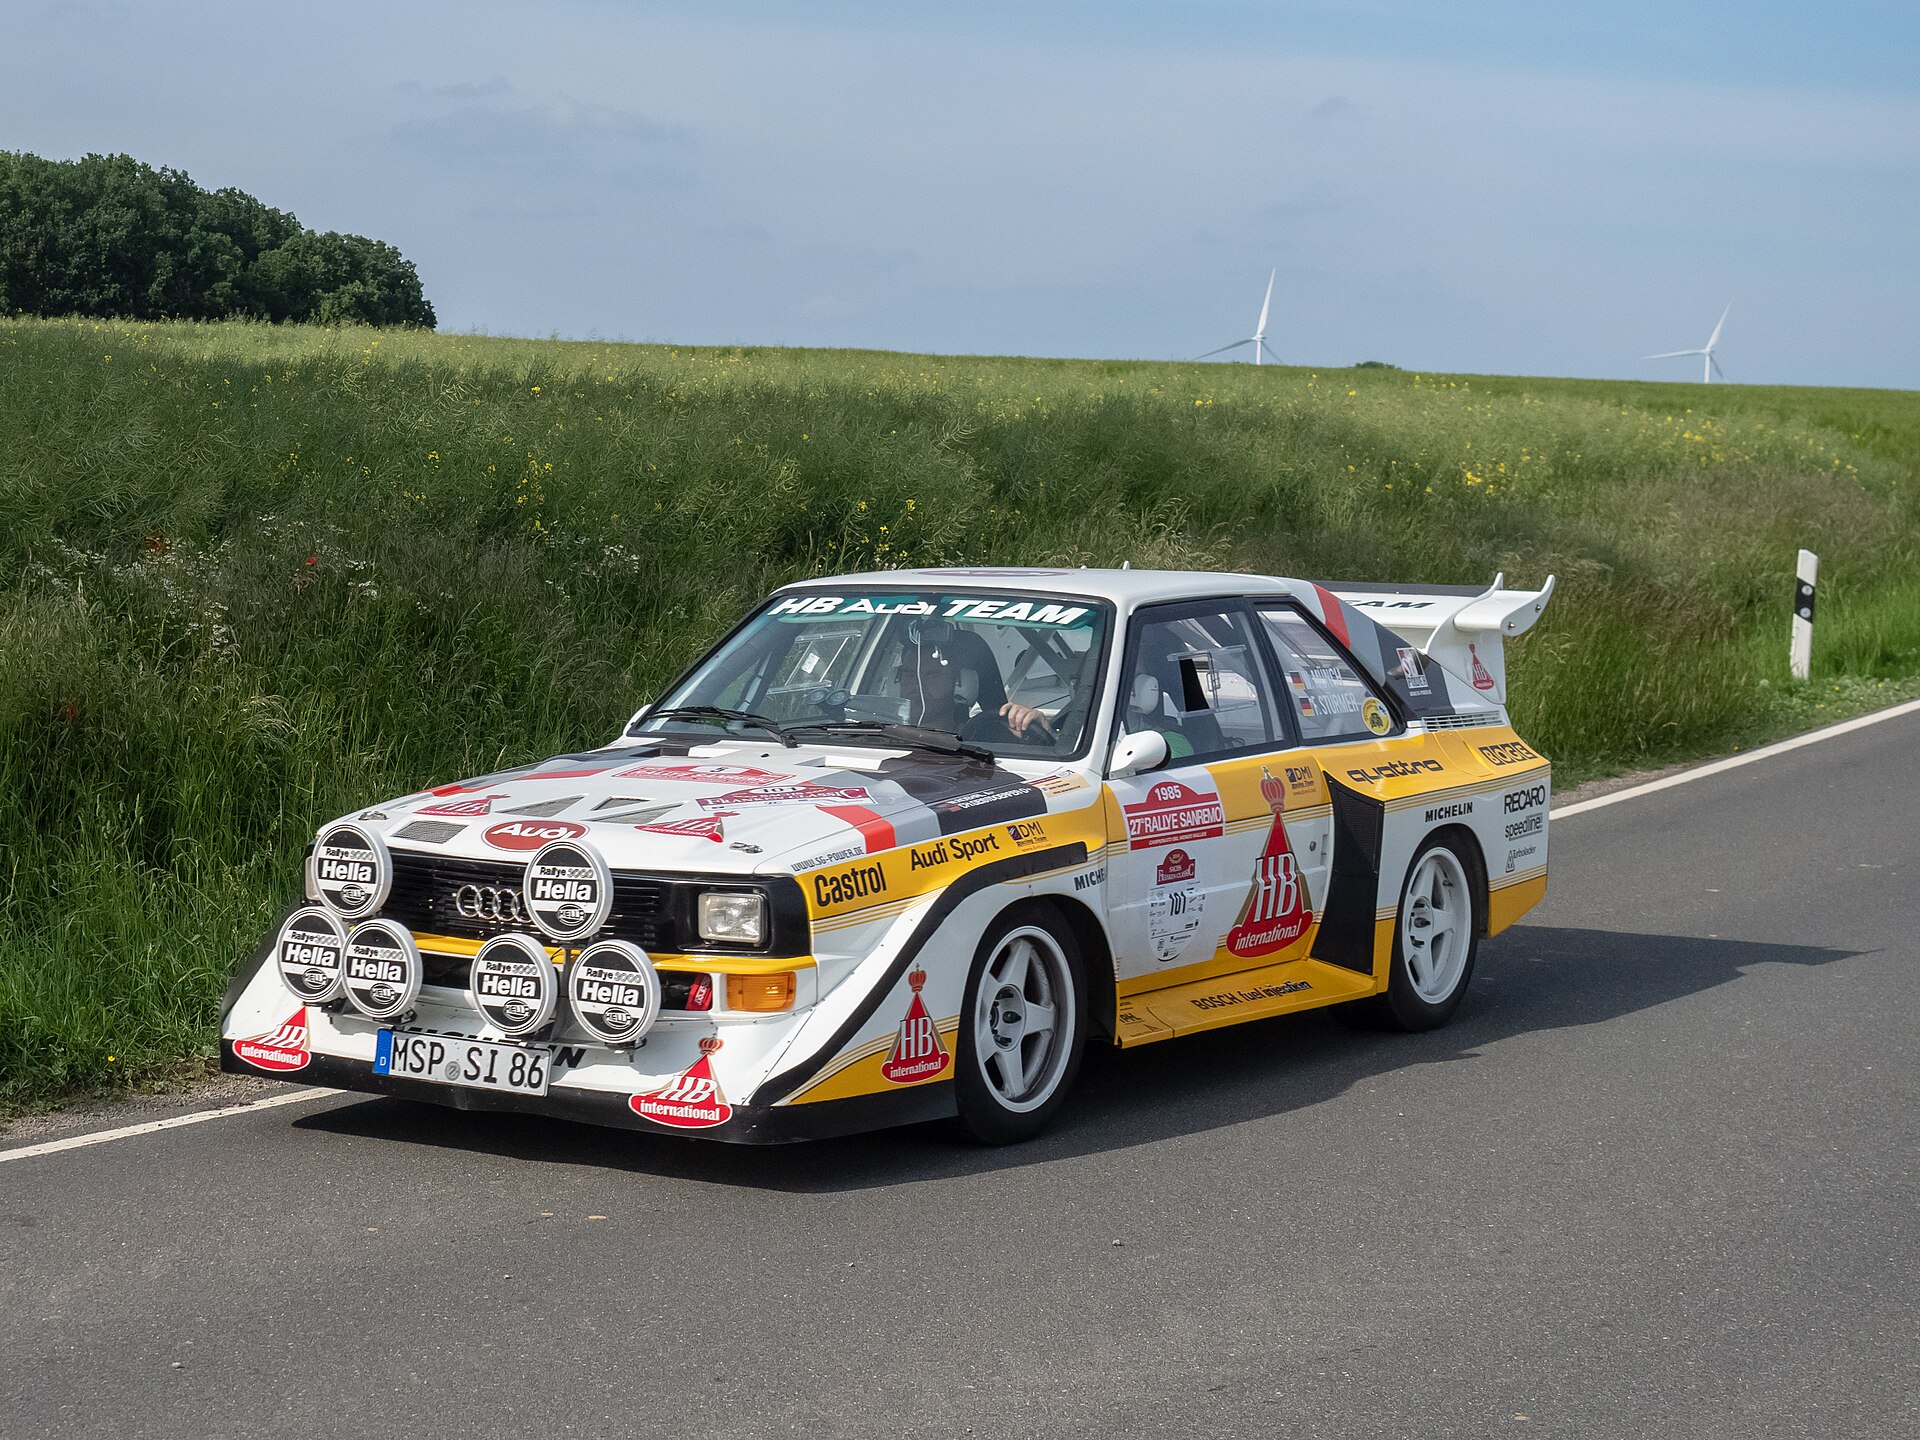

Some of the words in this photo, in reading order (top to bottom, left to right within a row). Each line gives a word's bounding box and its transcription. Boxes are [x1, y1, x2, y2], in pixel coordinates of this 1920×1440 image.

[767, 597, 845, 615] HB
[837, 598, 938, 616] Audi
[941, 599, 1090, 625] TEAM
[1478, 741, 1538, 766] BOGE
[1293, 766, 1313, 780] DMI
[1346, 759, 1444, 785] quattro
[1154, 785, 1182, 801] 1985
[1504, 785, 1546, 814] RECARO
[1144, 813, 1179, 834] RALLYE
[1179, 806, 1222, 828] SANREMO
[1424, 801, 1473, 823] MICHELIN
[495, 822, 578, 840] Audi
[663, 820, 721, 831] HB
[1018, 821, 1044, 837] DMI
[325, 847, 349, 859] Rallye
[910, 838, 949, 872] Audi
[952, 832, 1000, 862] Sport
[320, 859, 373, 882] Hella
[540, 866, 567, 877] Rallye
[567, 867, 595, 879] 3000
[535, 879, 592, 901] Hella
[813, 861, 888, 908] Castrol
[1253, 853, 1297, 923] HB
[1169, 891, 1187, 917] 101
[290, 931, 314, 943] Rallye
[1234, 917, 1303, 951] international
[284, 943, 336, 967] Hella
[354, 945, 379, 957] Rallye
[350, 957, 402, 980] Hella
[485, 961, 512, 974] Rallye
[512, 963, 538, 975] 3000
[585, 967, 613, 980] Rallye
[613, 970, 642, 984] 3000
[481, 973, 537, 997] Hella
[580, 980, 640, 1006] Hella
[1190, 992, 1243, 1010] BOSCH
[1238, 987, 1266, 1003] fuel
[1262, 980, 1313, 998] injection
[254, 1024, 308, 1048] HB
[899, 1015, 935, 1061] HB
[240, 1043, 303, 1066] international
[379, 1056, 386, 1066] D
[390, 1035, 445, 1075] MSP
[463, 1046, 499, 1084] SI
[508, 1052, 544, 1089] 86
[889, 1055, 942, 1079] international
[657, 1074, 720, 1103] HB
[639, 1099, 721, 1122] international
